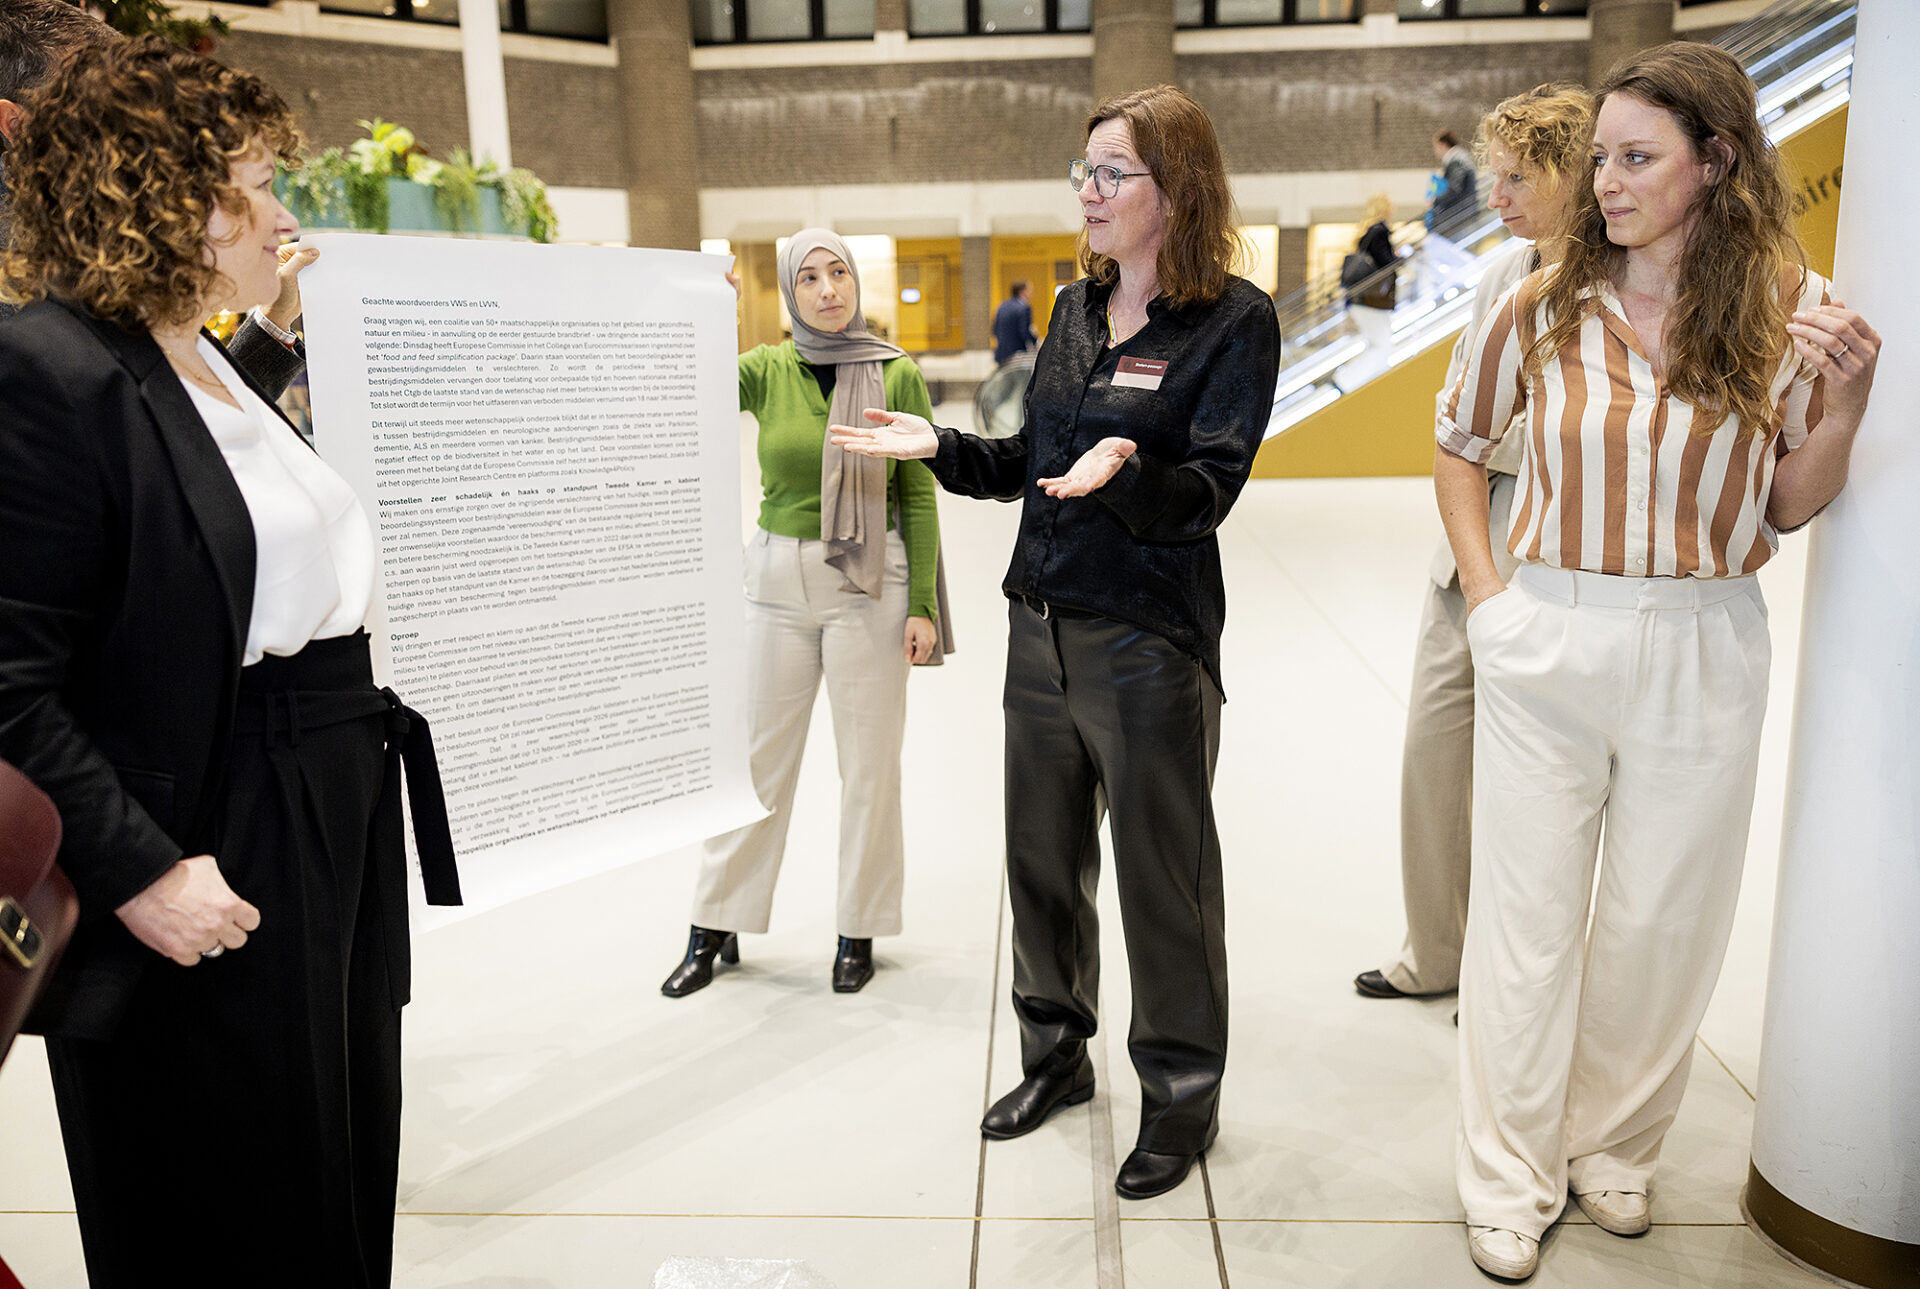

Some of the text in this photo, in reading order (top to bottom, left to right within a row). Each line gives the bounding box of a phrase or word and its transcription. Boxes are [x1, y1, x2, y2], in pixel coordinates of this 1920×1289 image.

[362, 297, 394, 305] Geachte
[395, 298, 449, 307] woordvoerders
[364, 317, 386, 326] Graag
[440, 330, 476, 339] aanvulling
[403, 341, 432, 351] Dinsdag
[453, 342, 485, 351] Europese
[436, 353, 484, 362] simplification
[368, 364, 466, 374] gewasbestrijdingsmiddelen
[368, 376, 445, 386] bestrijdingsmiddelen
[404, 388, 421, 398] Ctgb
[397, 400, 418, 408] wordt
[430, 400, 455, 409] termijn
[384, 420, 407, 429] terwijl
[419, 418, 443, 427] steeds
[465, 415, 524, 425] wetenschappelijk
[412, 428, 486, 439] bestrijdingsmiddelen
[413, 442, 428, 450] ALS
[441, 440, 476, 448] meerdere
[375, 455, 404, 465] negatief
[407, 454, 428, 462] effect
[454, 450, 500, 459] biodiversiteit
[435, 464, 459, 473] belang
[483, 462, 515, 470] Europese
[401, 476, 439, 487] opgerichte
[459, 473, 491, 482] Research
[379, 496, 422, 506] Voorstellen
[455, 489, 492, 500] schadelijk
[517, 486, 538, 495] haaks
[563, 482, 597, 491] standpunt
[605, 479, 629, 488] Tweede
[380, 511, 391, 519] Wij
[393, 509, 418, 517] maken
[435, 505, 464, 514] ernstige
[466, 504, 489, 512] zorgen
[381, 518, 457, 530] beoordelingssysteem
[399, 532, 410, 540] zal
[399, 541, 445, 552] onwenselijke
[415, 565, 440, 573] waarin
[386, 580, 419, 589] scherpen
[432, 576, 451, 584] basis
[402, 589, 423, 598] haaks
[391, 632, 419, 642] Oproep
[392, 642, 432, 653] Wij dringen
